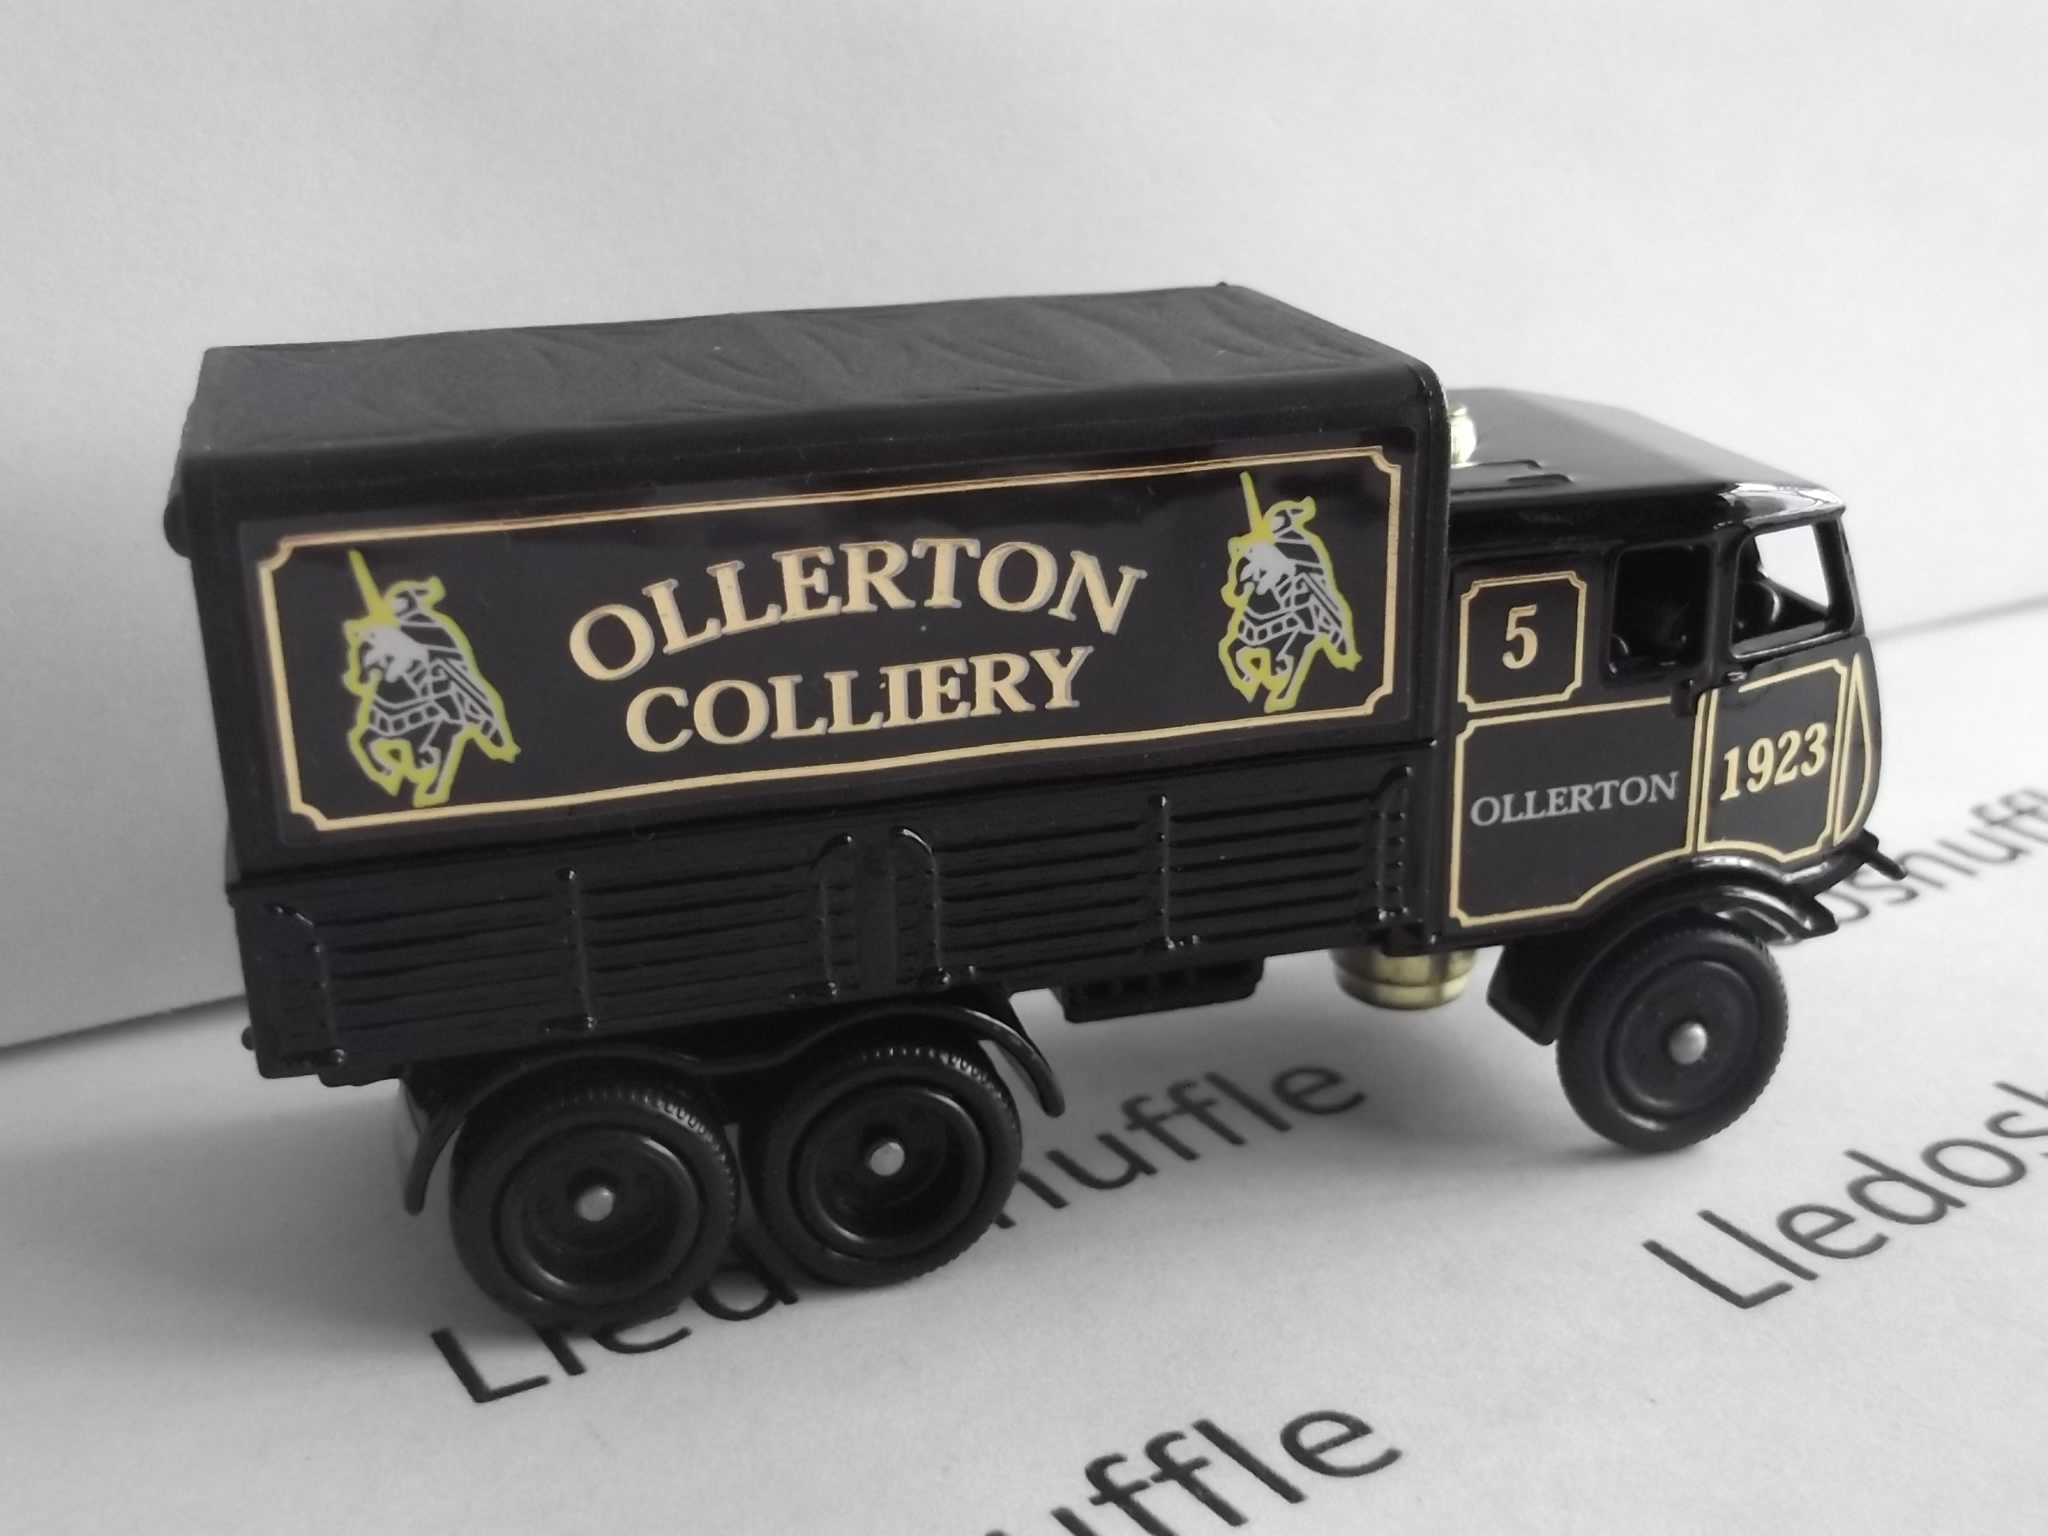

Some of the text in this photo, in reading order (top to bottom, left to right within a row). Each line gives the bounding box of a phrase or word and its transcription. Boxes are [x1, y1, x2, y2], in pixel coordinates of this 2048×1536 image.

[569, 538, 1148, 681] OLLERTON
[1502, 604, 1538, 669] 5
[626, 646, 1094, 752] COLLIERY
[1470, 771, 1679, 826] OLLERTON
[1720, 722, 1828, 801] 1923
